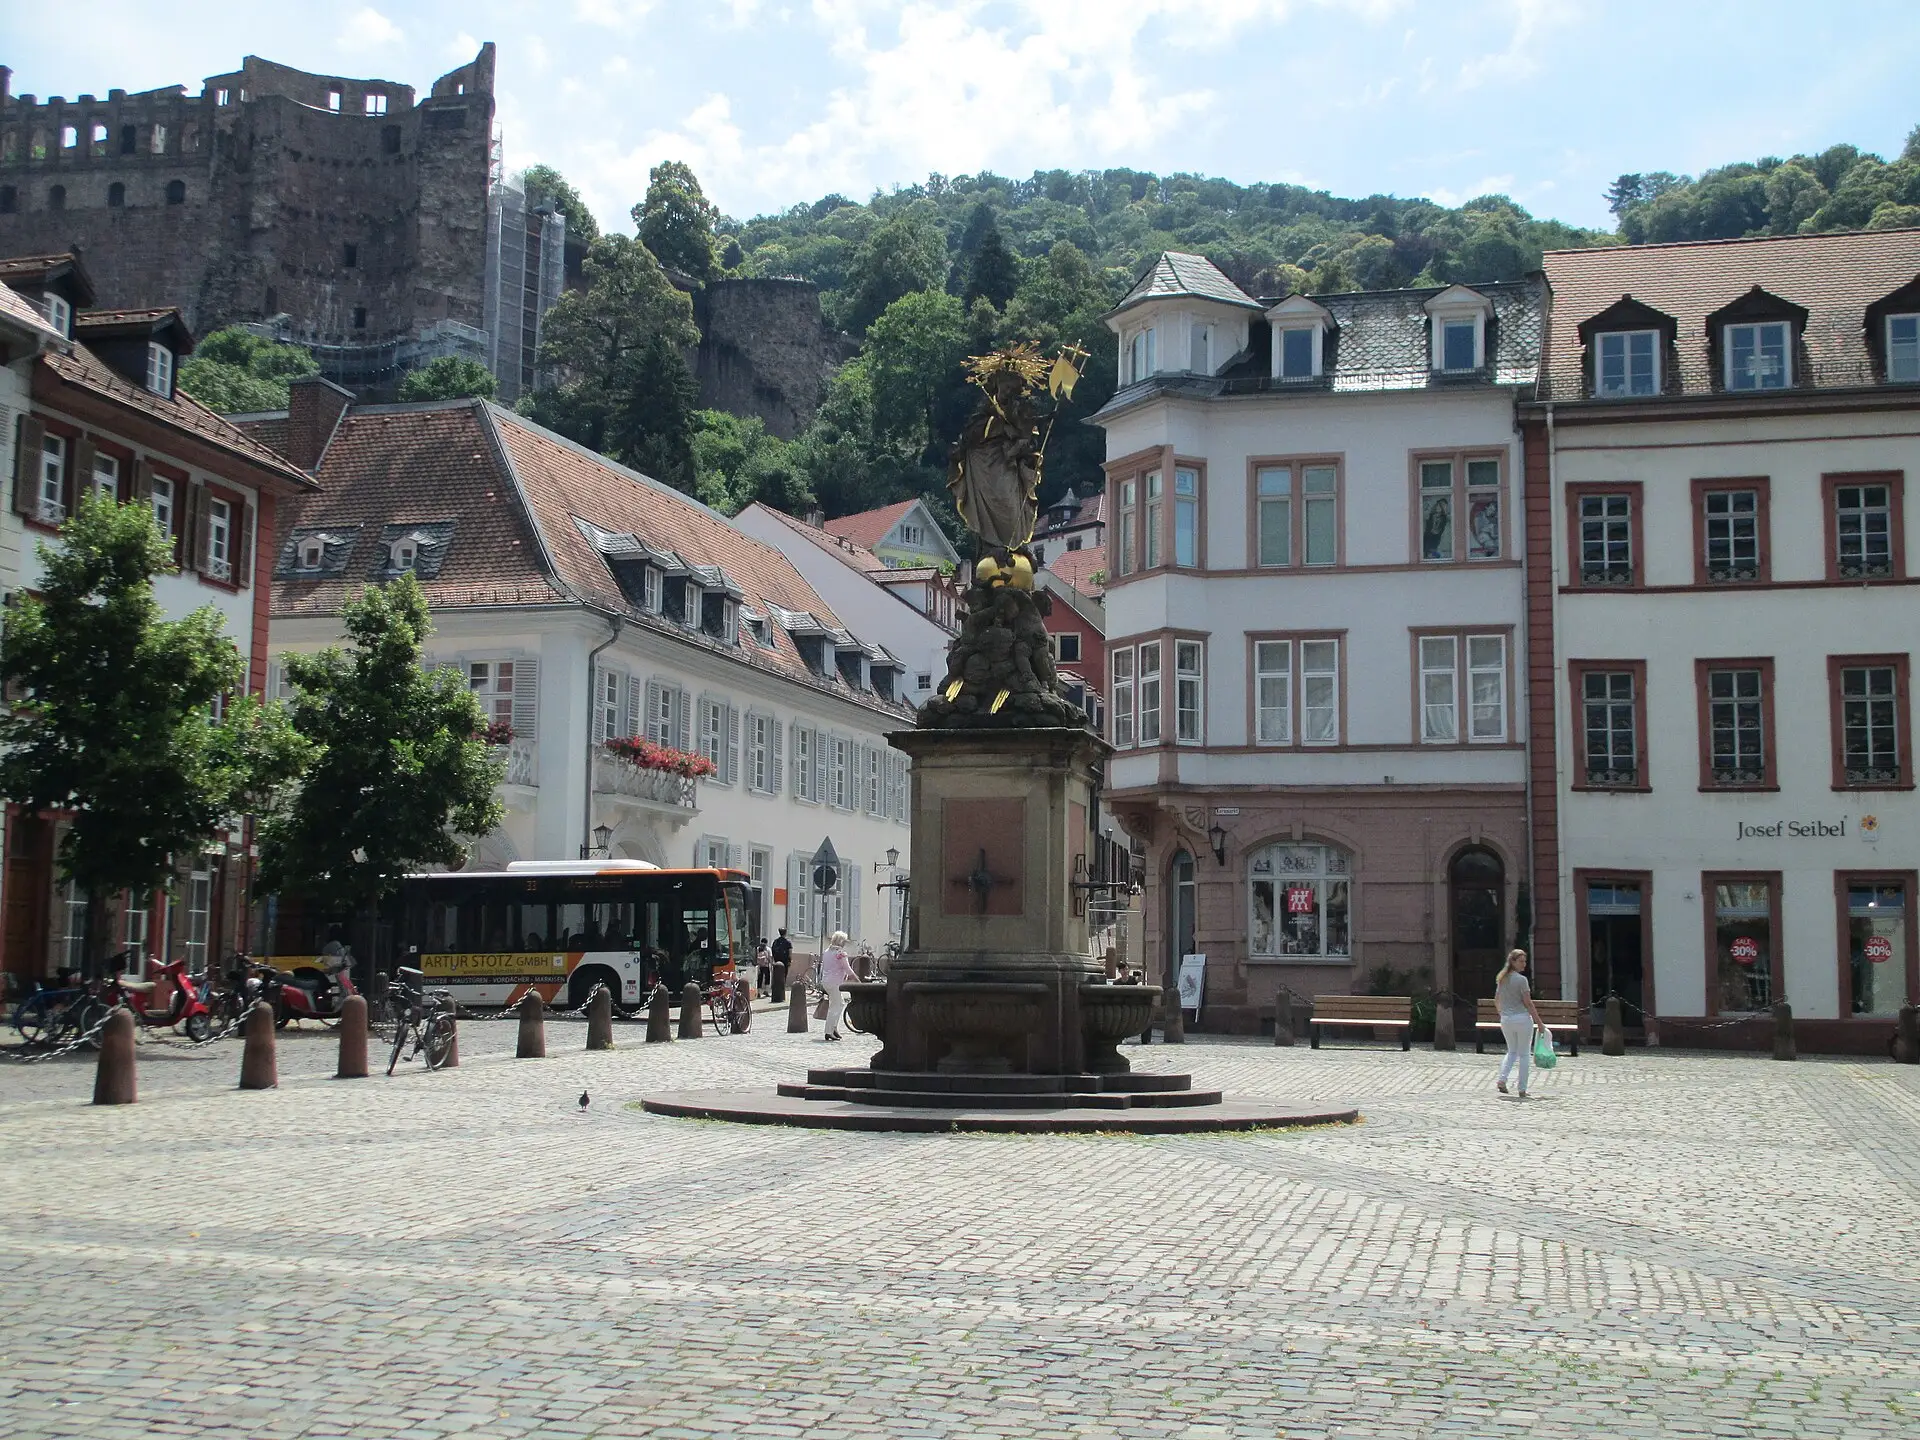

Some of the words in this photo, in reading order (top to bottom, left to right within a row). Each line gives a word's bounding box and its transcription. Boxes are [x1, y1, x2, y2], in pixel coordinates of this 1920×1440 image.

[1736, 820, 1783, 841] Josef
[1788, 820, 1845, 837] Seibel
[1730, 945, 1757, 956] -30%
[1864, 945, 1891, 956] -30%
[424, 955, 468, 968] ARTUR
[471, 954, 513, 967] STOTZ
[516, 956, 548, 967] GMBH
